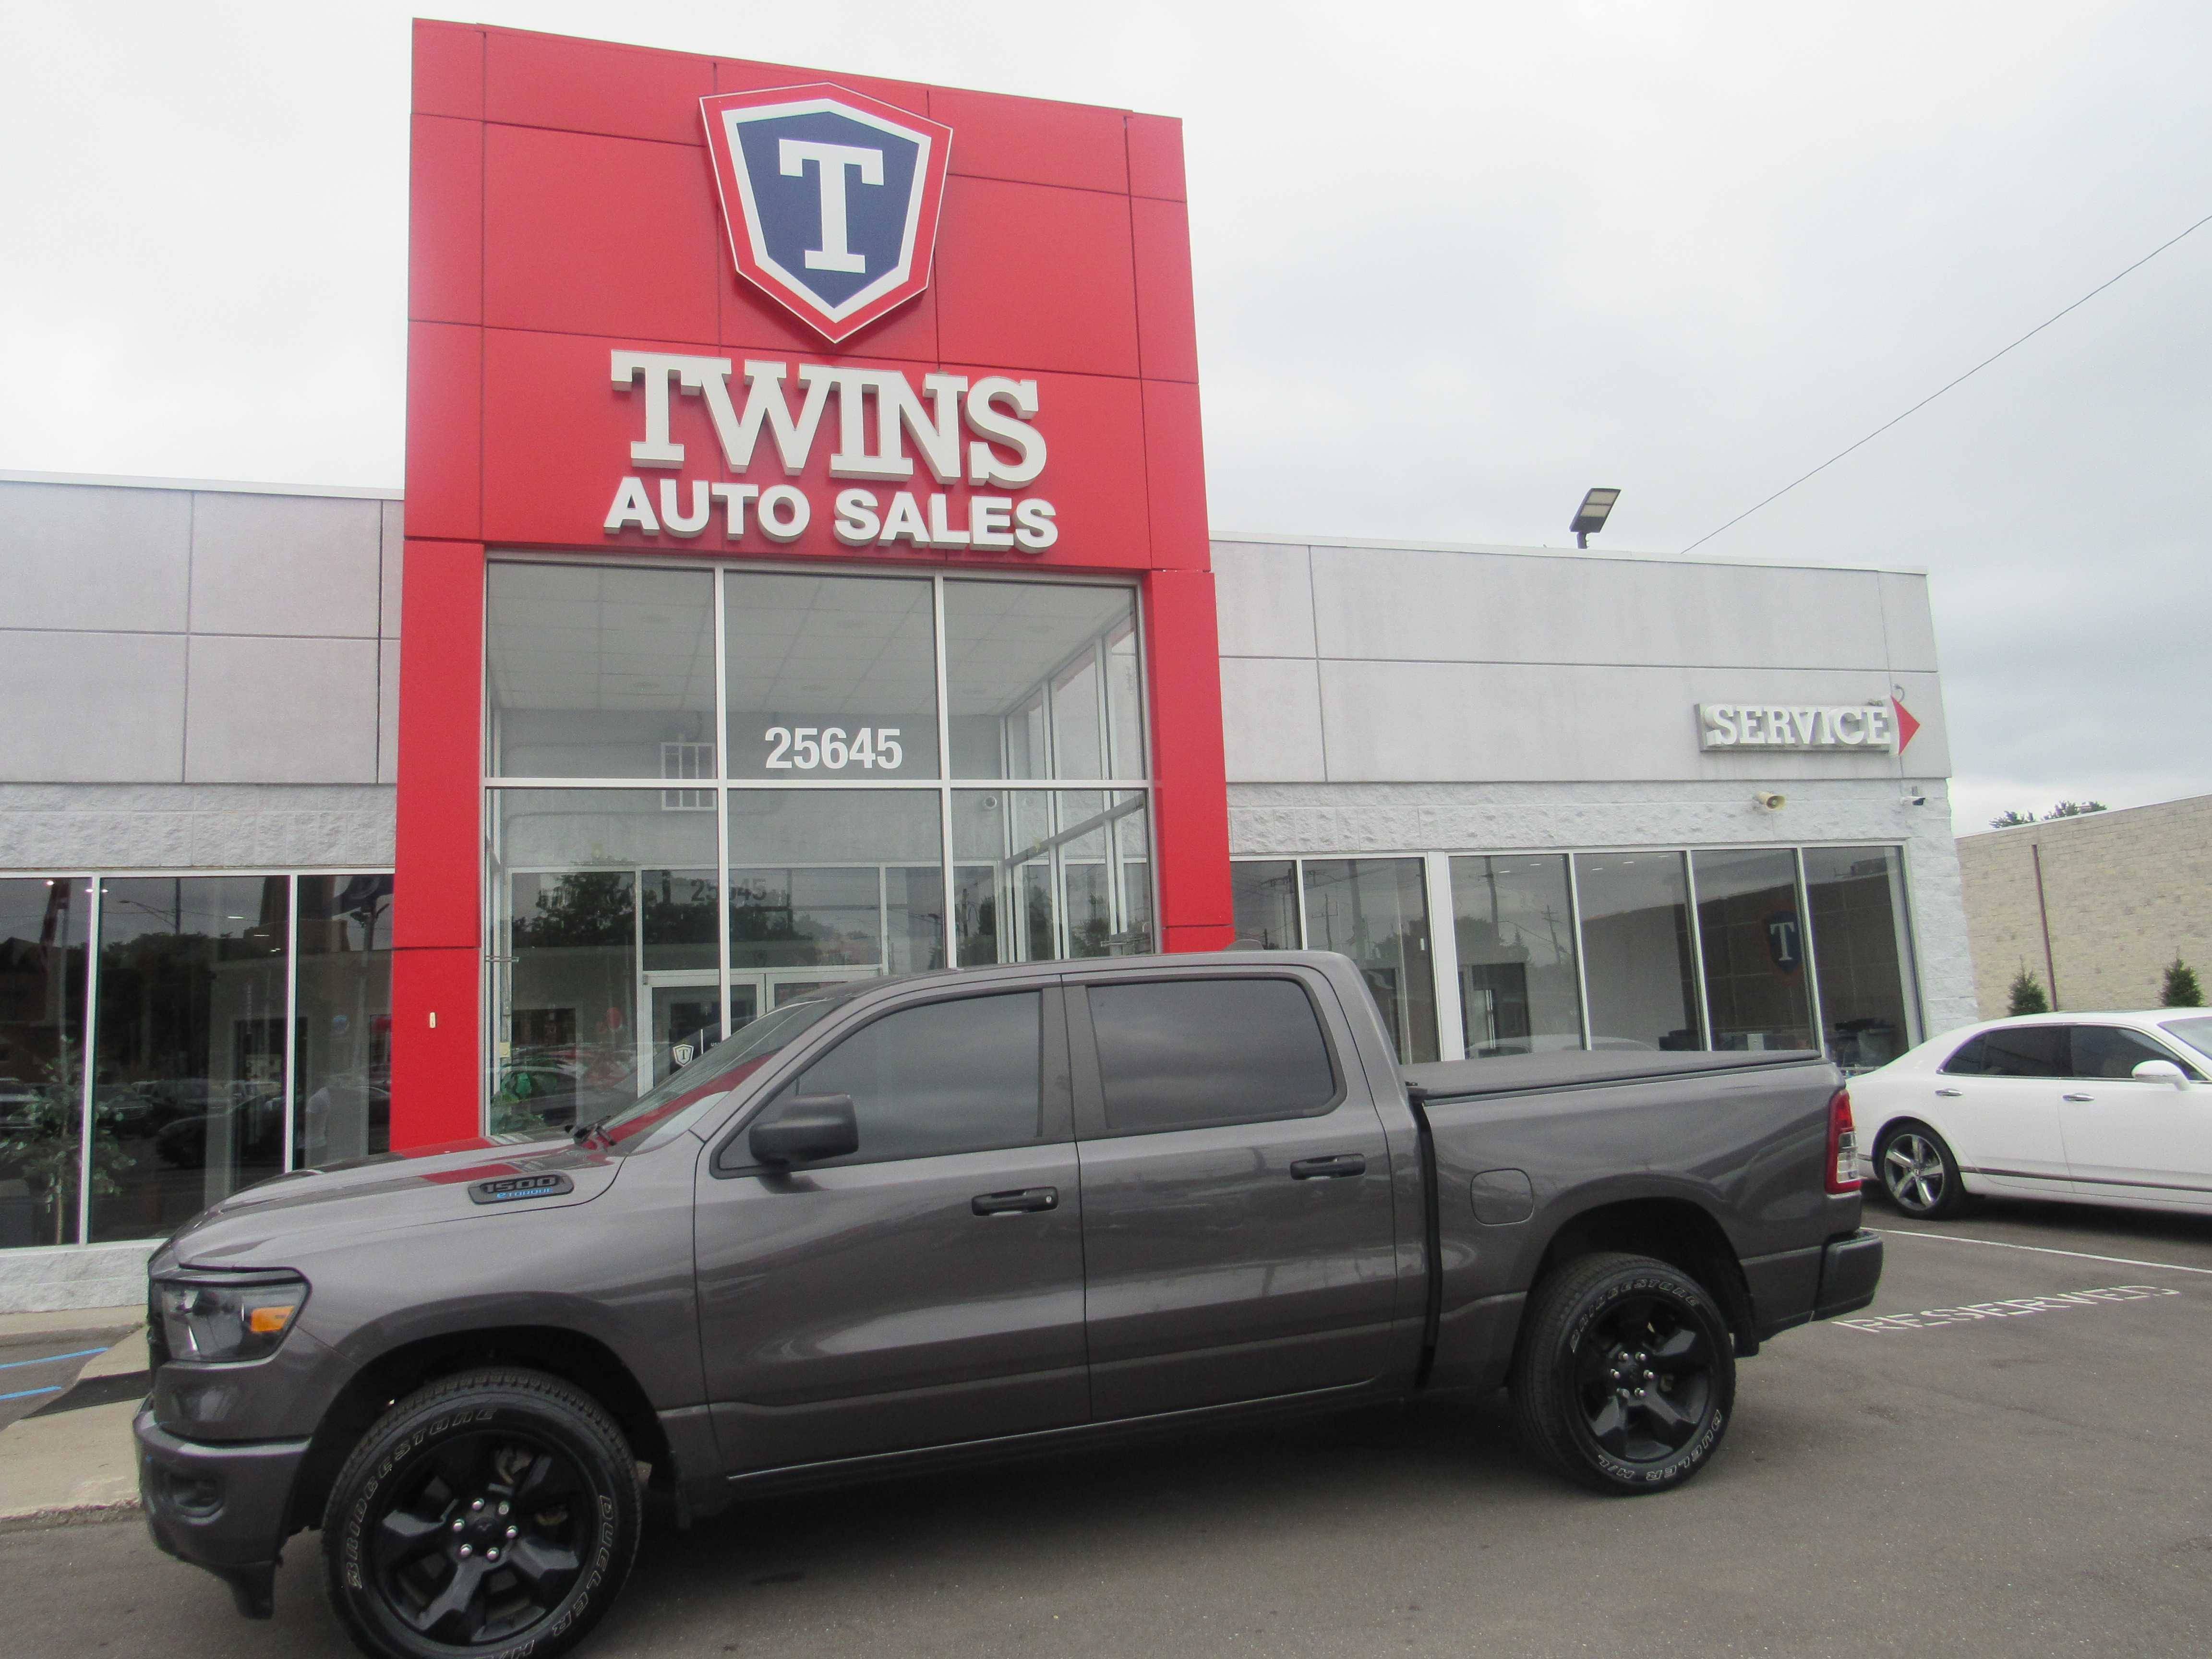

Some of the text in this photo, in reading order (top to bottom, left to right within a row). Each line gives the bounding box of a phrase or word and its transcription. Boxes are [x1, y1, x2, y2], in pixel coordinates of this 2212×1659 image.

[779, 138, 884, 274] T
[611, 349, 1046, 489] TWINS
[603, 476, 1058, 554] AUTO SALES
[765, 727, 902, 769] 25645
[1704, 703, 1890, 746] SERVICE
[1769, 921, 1796, 961] T
[678, 1048, 689, 1060] T
[483, 1176, 556, 1193] 1500
[1831, 1285, 2180, 1333] RESERVED
[1645, 1409, 1722, 1481] DUELER
[345, 1408, 498, 1590] BRIDGESTONE
[552, 1495, 614, 1636] DUELER
